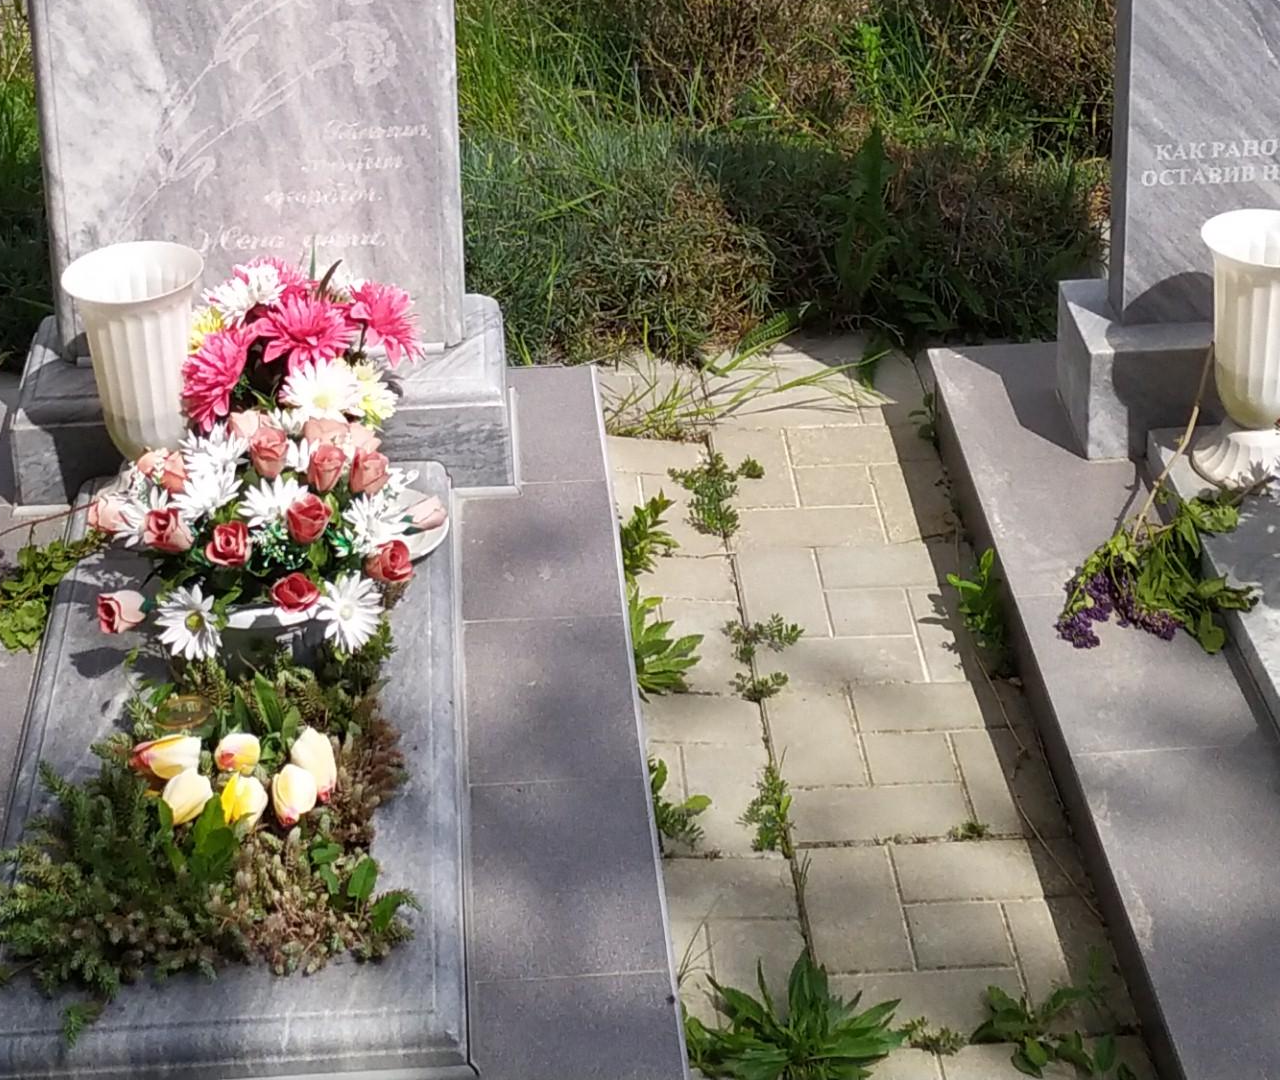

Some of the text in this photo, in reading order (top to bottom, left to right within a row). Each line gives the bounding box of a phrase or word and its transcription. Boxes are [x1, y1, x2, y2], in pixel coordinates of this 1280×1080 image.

[1156, 142, 1205, 161] КАК
[1211, 139, 1278, 159] РАНО
[1141, 166, 1256, 187] ОСТАВИВ
